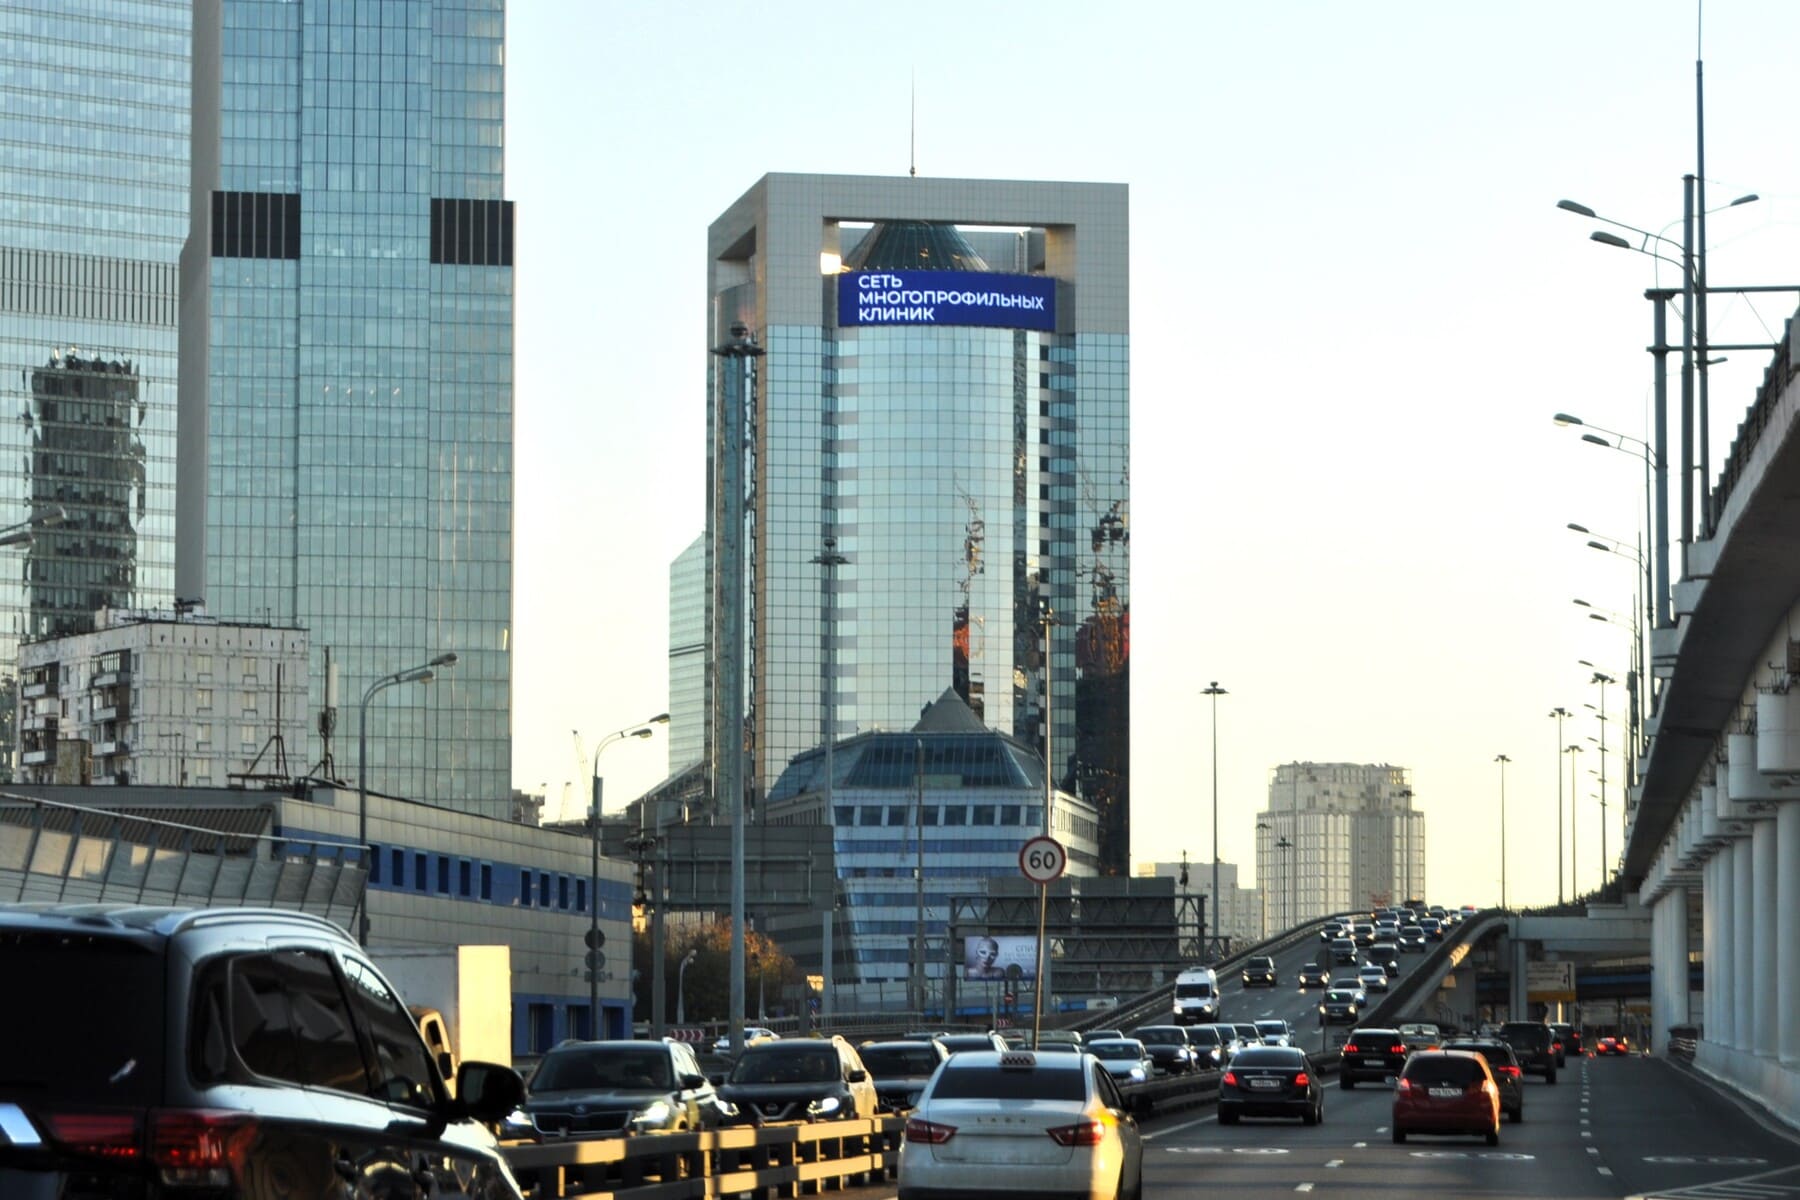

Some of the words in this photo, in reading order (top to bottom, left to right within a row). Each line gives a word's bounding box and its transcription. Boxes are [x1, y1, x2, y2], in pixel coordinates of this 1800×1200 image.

[858, 275, 902, 289] СЕТЬ
[859, 290, 1044, 310] МНОГОПРОФИЛЬНЫХ
[859, 307, 934, 321] КЛИНИК
[1030, 850, 1056, 870] 60
